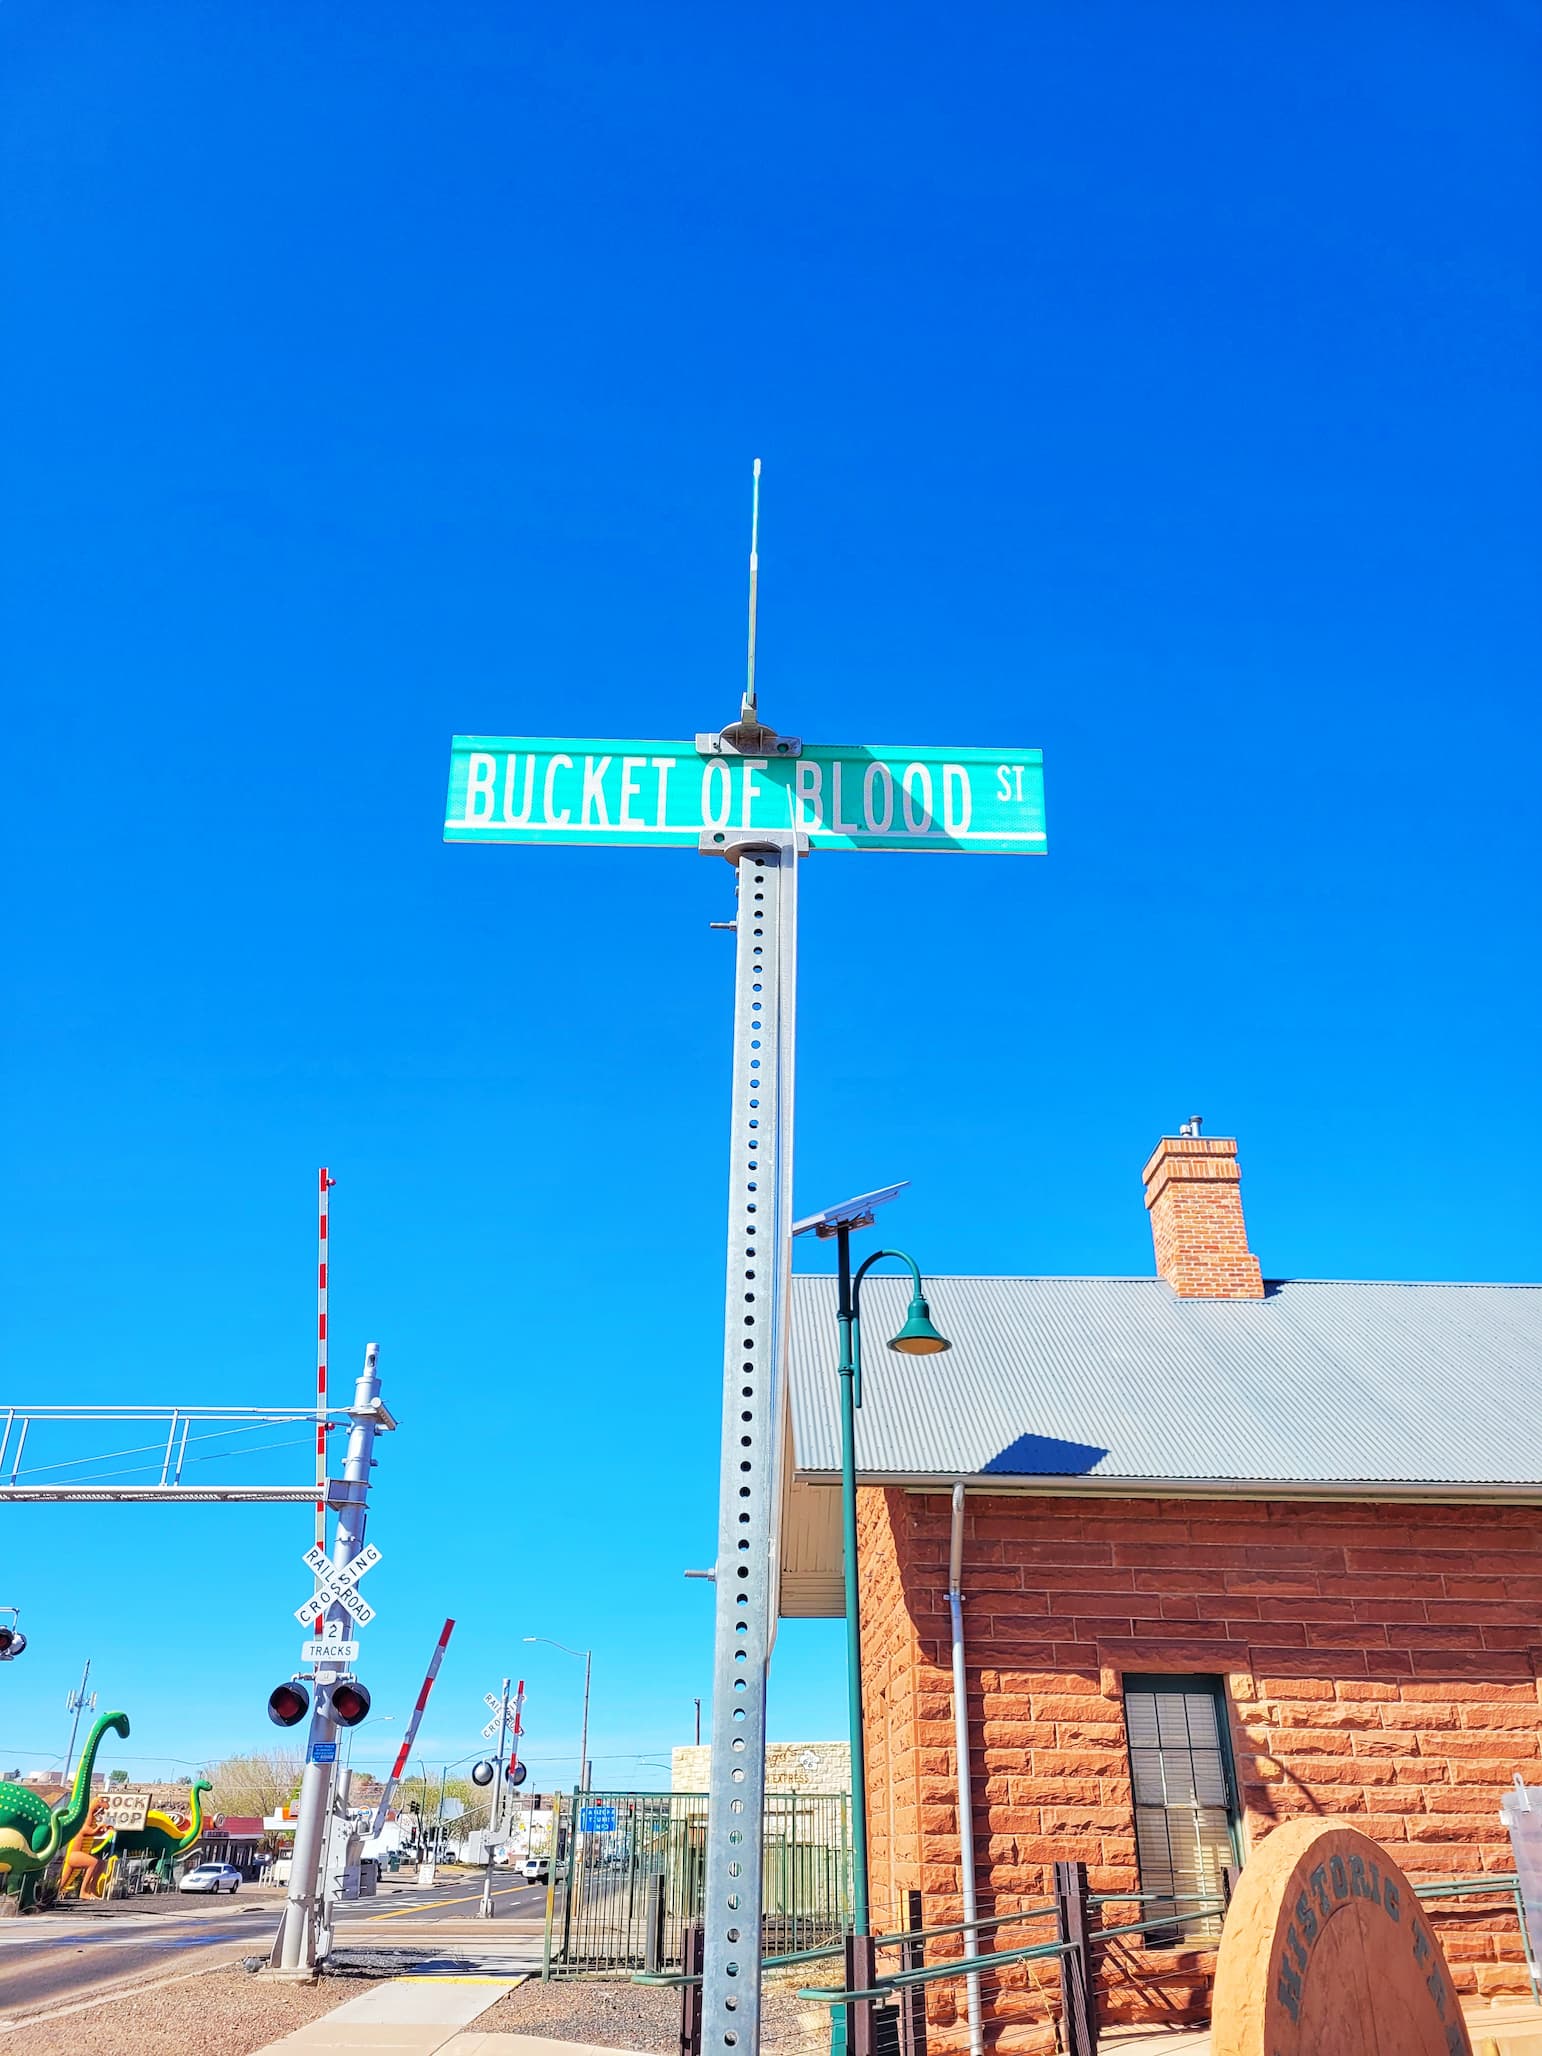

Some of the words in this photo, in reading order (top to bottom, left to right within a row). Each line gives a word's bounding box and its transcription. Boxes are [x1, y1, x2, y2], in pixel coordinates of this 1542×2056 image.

[465, 752, 676, 828] BUCKET
[700, 758, 767, 828] OF
[794, 760, 973, 834] BLOOD
[997, 764, 1025, 803] ST
[299, 1547, 378, 1623] CROSSING
[306, 1549, 372, 1623] RAILROAD
[309, 1645, 352, 1657] TRACKS
[328, 1624, 337, 1638] 2
[773, 1773, 810, 1784] EXPRESS
[1277, 1854, 1401, 2026] HISTORIC
